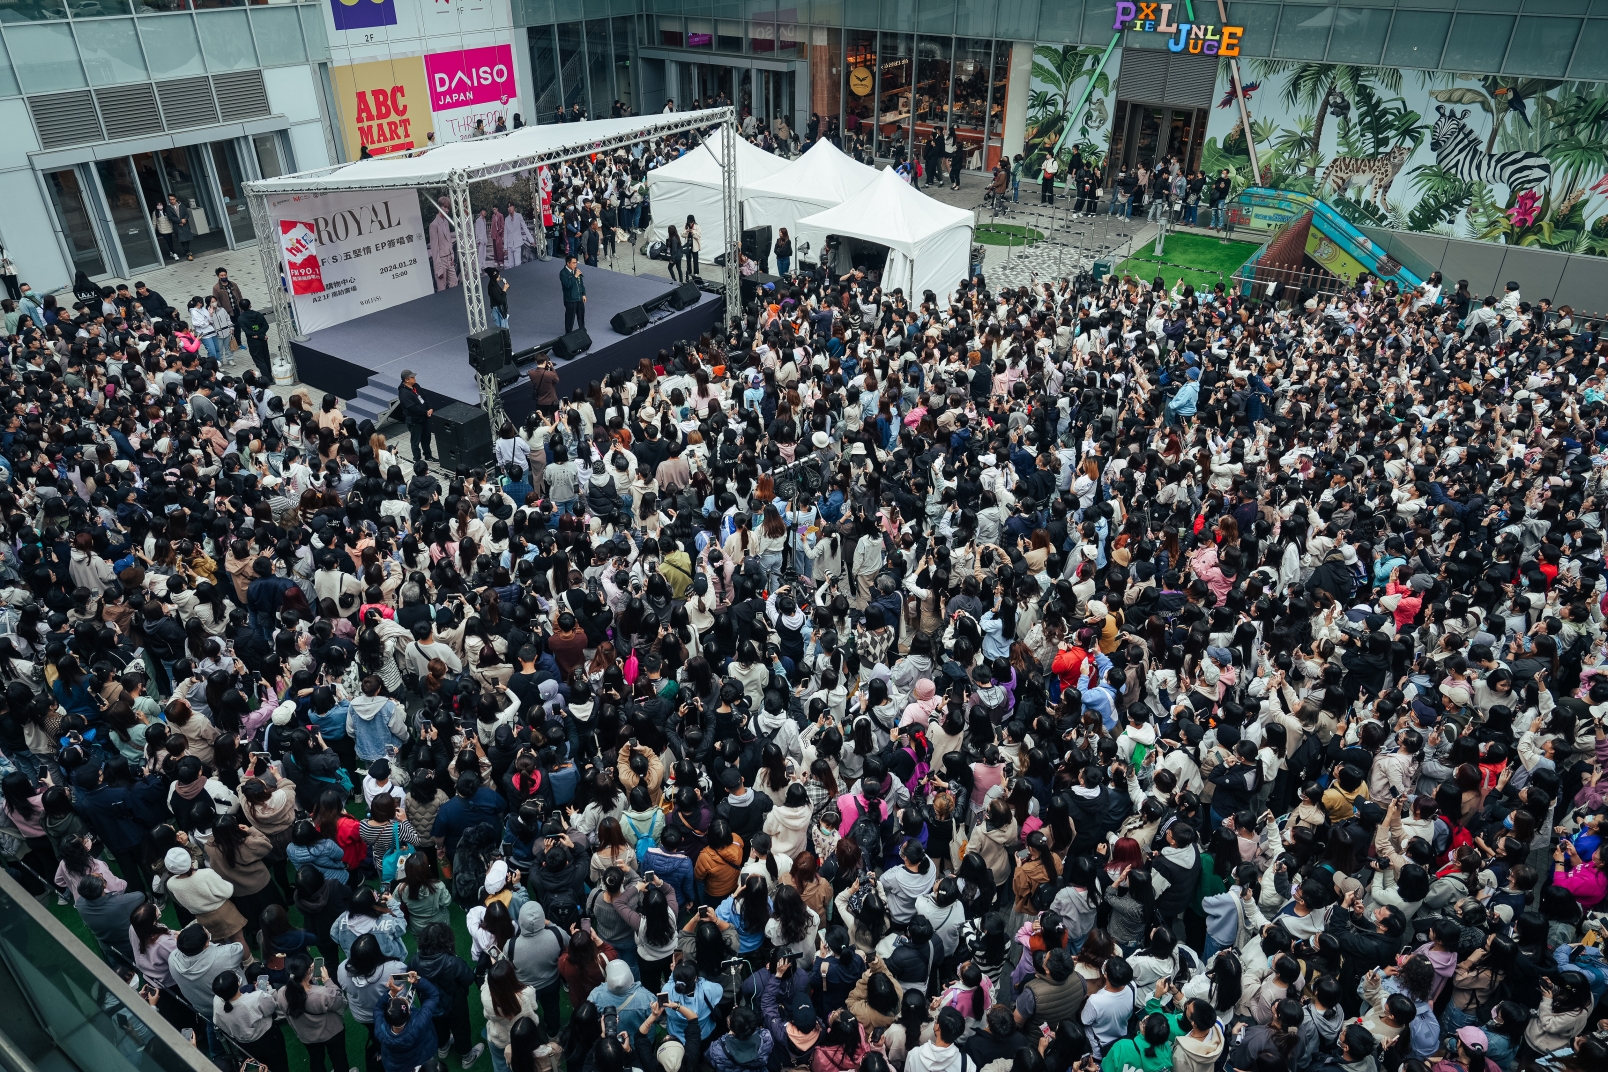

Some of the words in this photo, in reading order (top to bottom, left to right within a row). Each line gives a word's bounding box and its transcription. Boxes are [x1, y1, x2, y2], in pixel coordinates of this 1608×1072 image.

[364, 34, 374, 42] 2F
[434, 64, 508, 92] DAISO
[356, 85, 407, 123] ABC
[439, 91, 474, 105] JAPAN
[358, 118, 411, 147] MART
[380, 258, 418, 274] 2024.01.28
